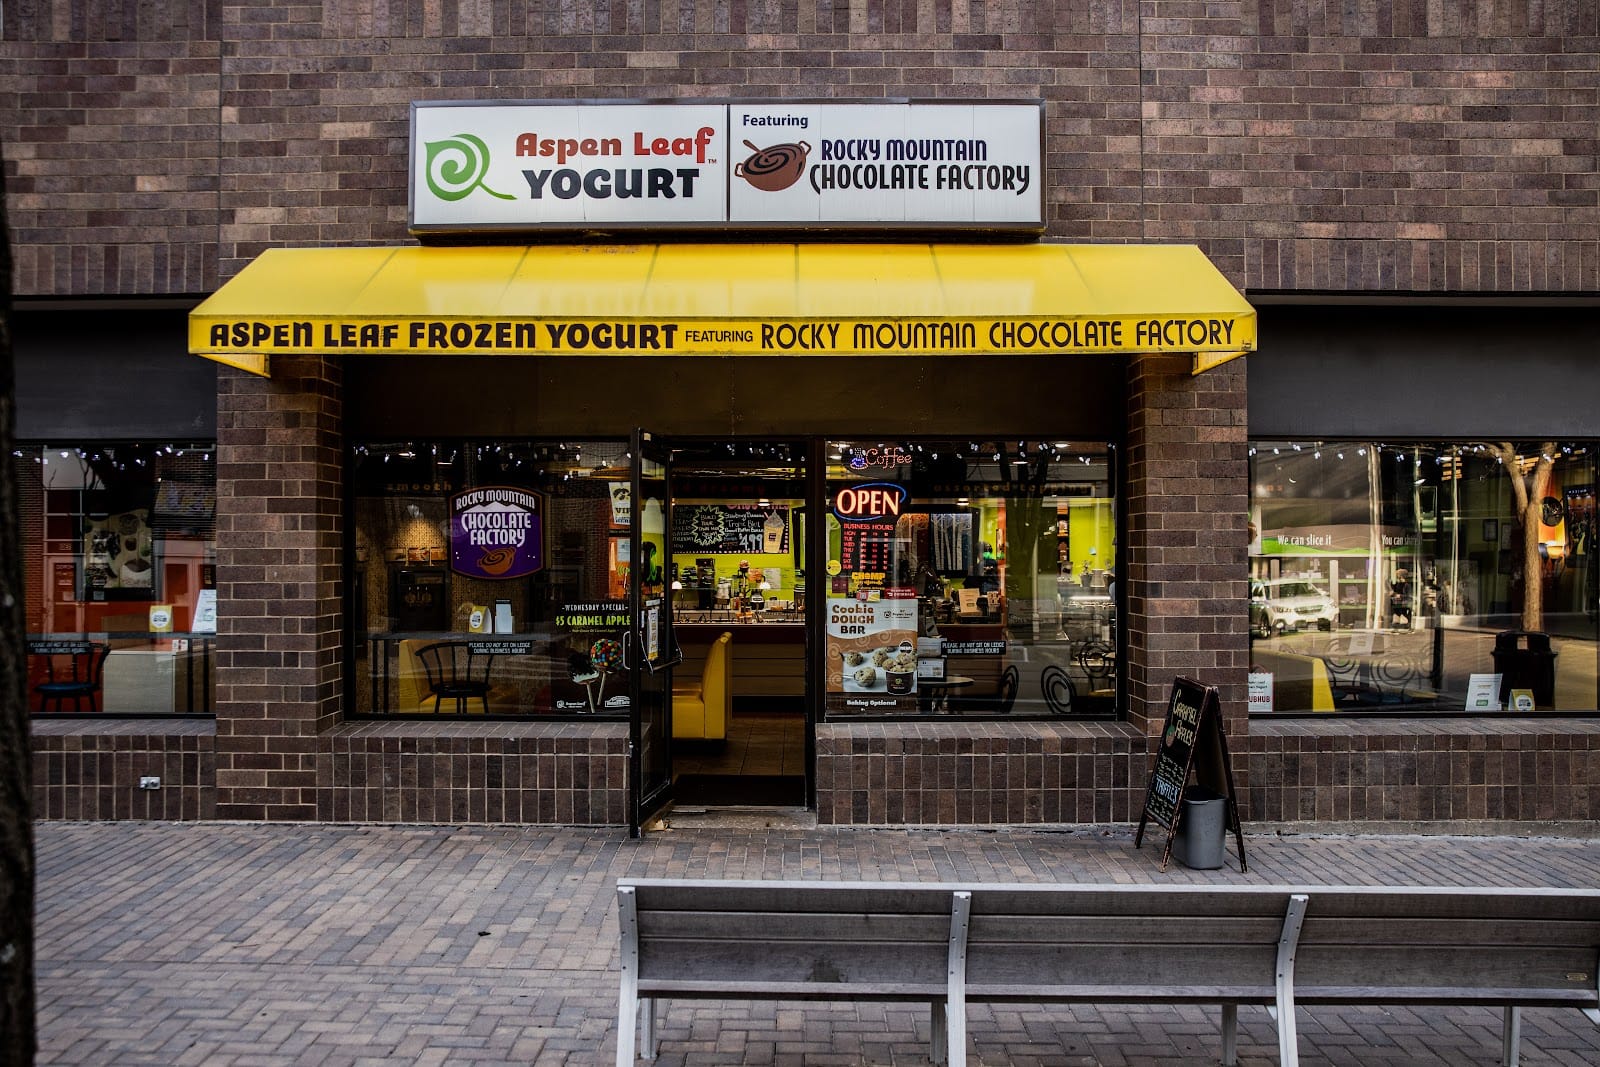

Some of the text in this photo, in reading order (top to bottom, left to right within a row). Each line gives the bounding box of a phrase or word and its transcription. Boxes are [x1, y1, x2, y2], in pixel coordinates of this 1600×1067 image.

[743, 115, 808, 129] Featuring
[516, 133, 621, 164] Aspen
[634, 127, 715, 163] Leaf
[821, 139, 987, 161] ROCKY MOUNTAIN
[521, 168, 700, 199] YOGURT
[809, 164, 1030, 195] CHOCOLATE FACTORY
[210, 319, 1235, 349] ASPEN LEAF FROZEN YOGURT FEATURING ROCKY MOUNTAIN CHOCOLATE FACTORY
[866, 447, 912, 469] Coffee
[456, 489, 535, 511] ROCKY MOUNTAIN
[837, 489, 899, 515] OPEN
[461, 512, 532, 532] CHOCOLATE
[470, 528, 526, 548] FACTORY
[1277, 534, 1332, 545] We can slice it
[1381, 535, 1392, 545] You
[1393, 536, 1403, 545] can
[832, 604, 874, 614] Cookie
[556, 616, 565, 626] $5
[567, 616, 604, 626] CARAMEL
[831, 615, 875, 624] DOUGH
[840, 625, 866, 634] BAR
